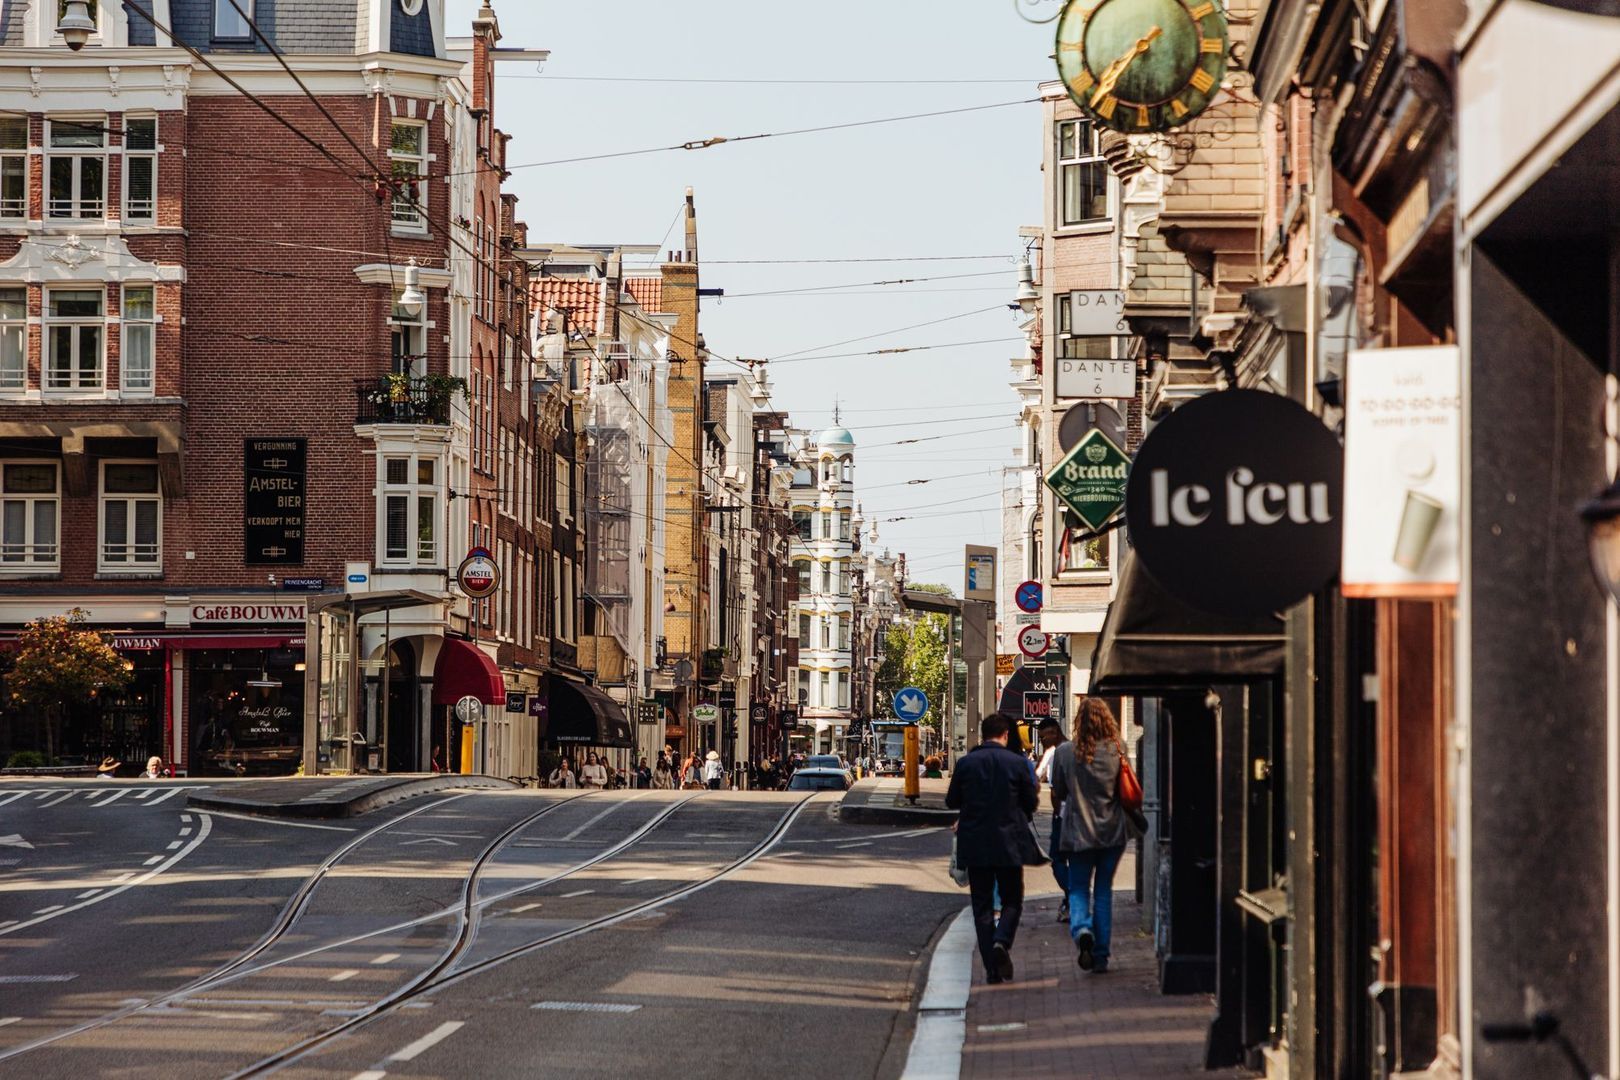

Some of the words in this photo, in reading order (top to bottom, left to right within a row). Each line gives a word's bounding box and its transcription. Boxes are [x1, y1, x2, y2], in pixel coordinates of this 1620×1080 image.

[1063, 361, 1130, 374] DANTE
[1094, 383, 1102, 395] 6
[1064, 460, 1128, 481] Brand
[277, 495, 302, 508] BIER
[1150, 467, 1213, 527] le
[285, 517, 301, 526] MEN
[284, 530, 301, 538] HIER
[192, 605, 229, 620] Café
[230, 605, 306, 620] BOUWM
[110, 638, 161, 649] UWMAN
